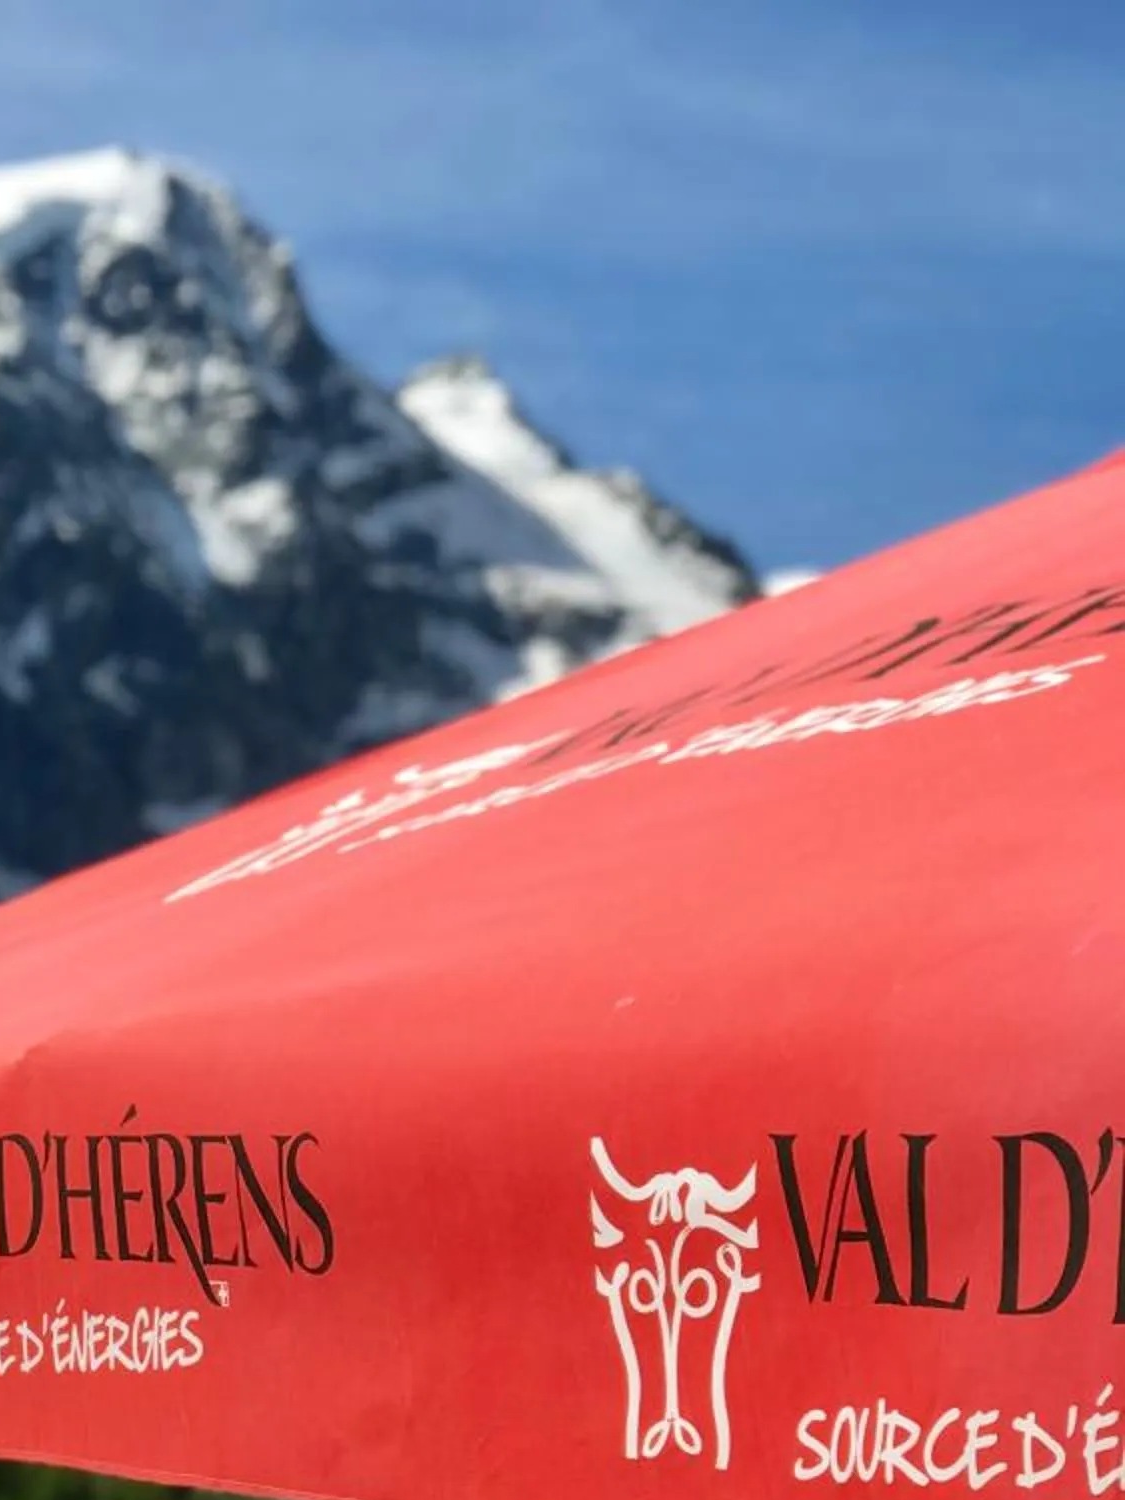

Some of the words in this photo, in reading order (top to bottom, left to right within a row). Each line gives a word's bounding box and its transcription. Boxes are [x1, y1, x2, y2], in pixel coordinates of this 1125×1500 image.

[768, 1128, 971, 1311] VAL
[991, 1126, 1125, 1325] D'
[18, 1299, 205, 1373] D'ÉNERGIES
[793, 1398, 1008, 1490] SOURCE
[1012, 1382, 1125, 1496] D'É
